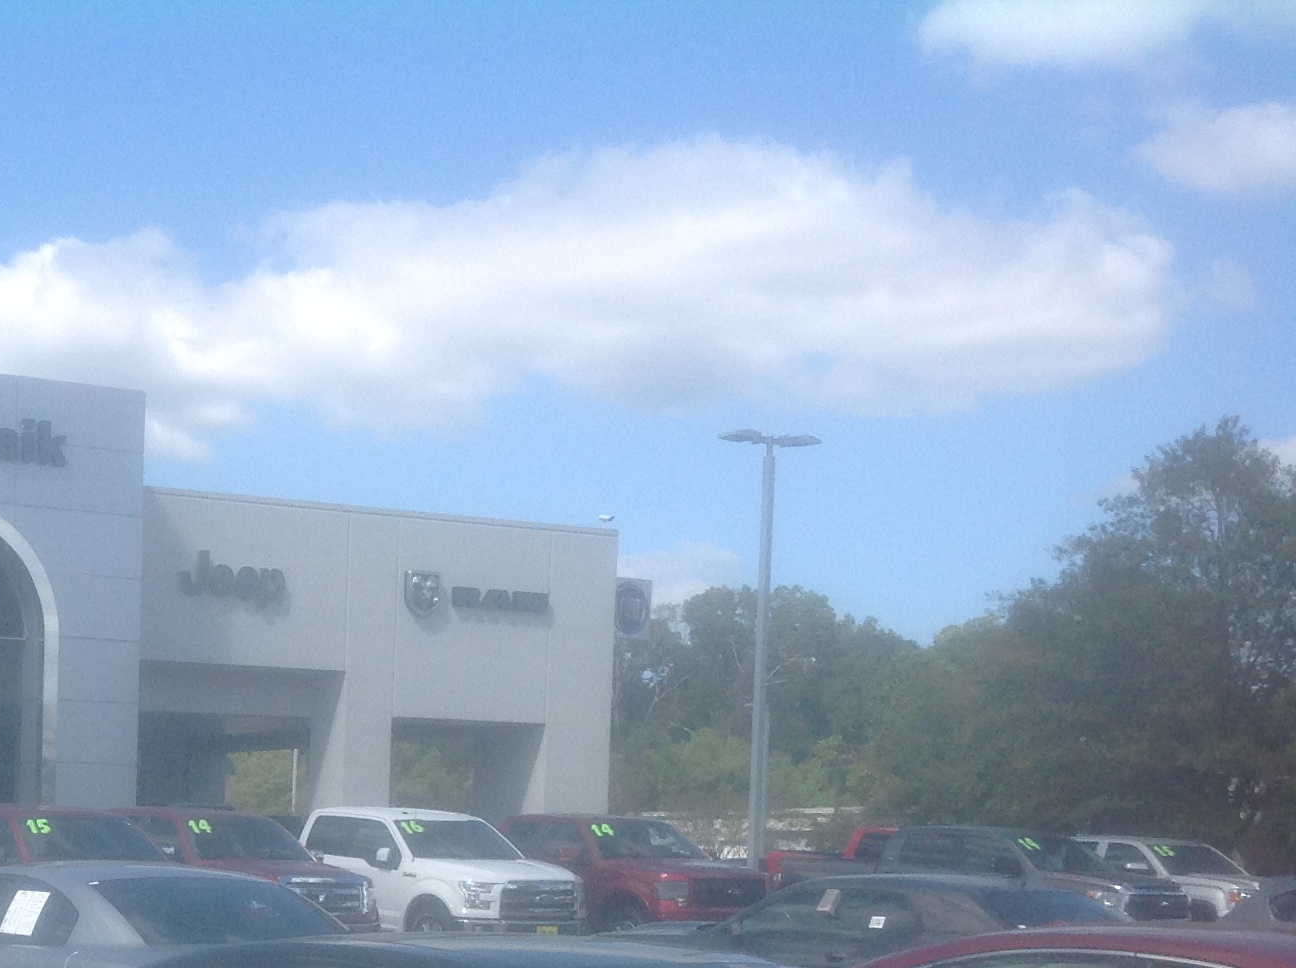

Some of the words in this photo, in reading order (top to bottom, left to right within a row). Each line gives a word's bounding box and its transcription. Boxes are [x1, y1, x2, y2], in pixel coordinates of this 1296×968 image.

[176, 549, 286, 608] Jeep
[26, 818, 52, 834] 15
[188, 819, 212, 834] 14
[400, 820, 424, 834] 16
[590, 823, 614, 837] 14
